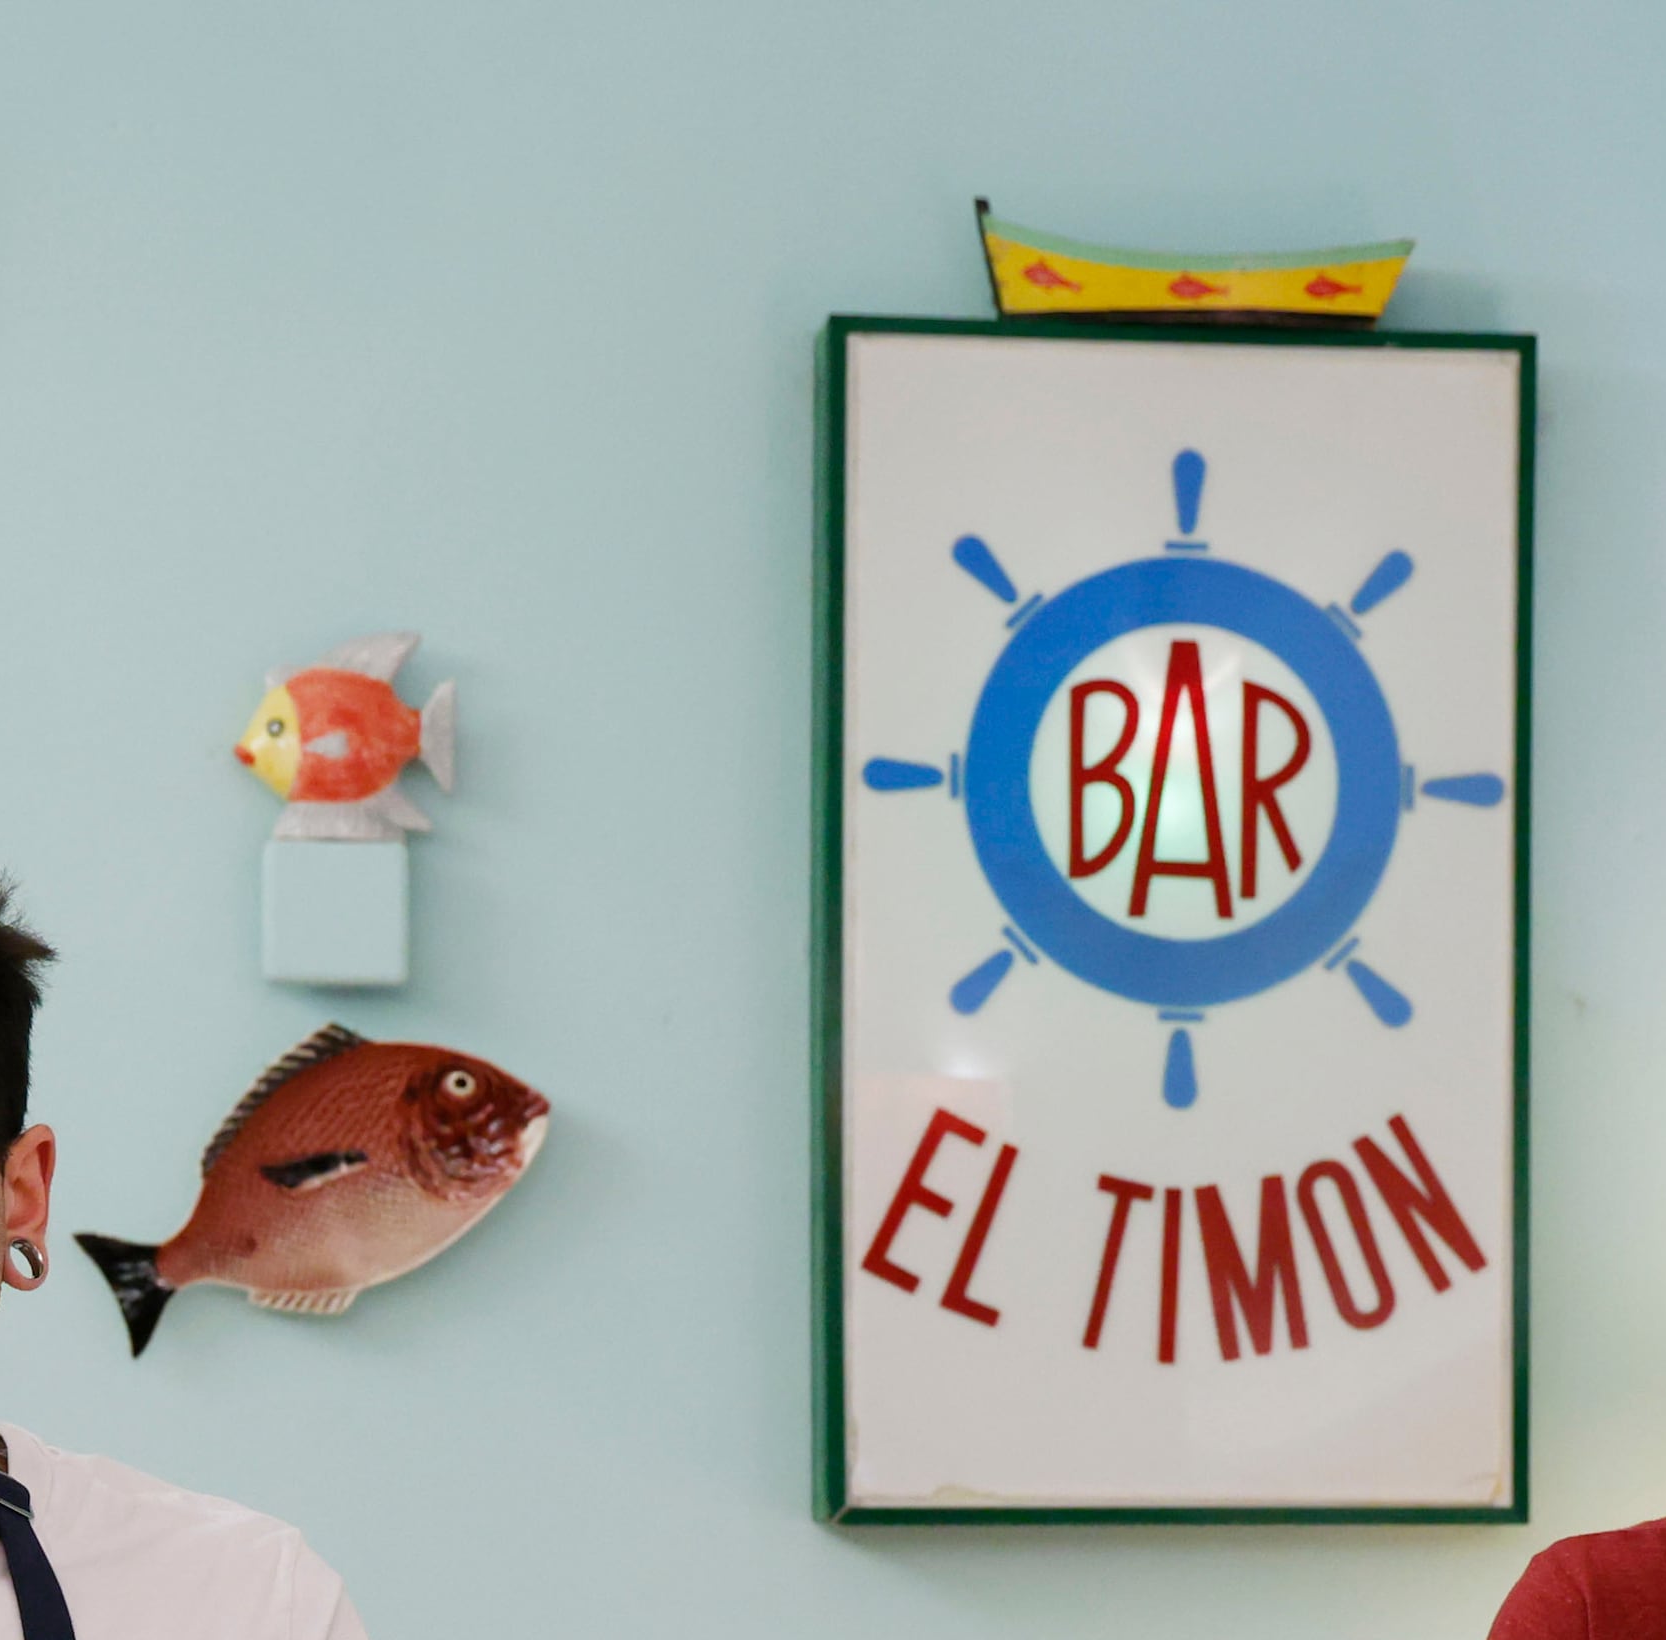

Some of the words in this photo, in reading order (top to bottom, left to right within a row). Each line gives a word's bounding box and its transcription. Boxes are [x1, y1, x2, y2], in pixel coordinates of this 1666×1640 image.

[1068, 640, 1312, 919] BAR
[861, 1107, 1020, 1328] EL
[1081, 1114, 1488, 1364] TIMON
